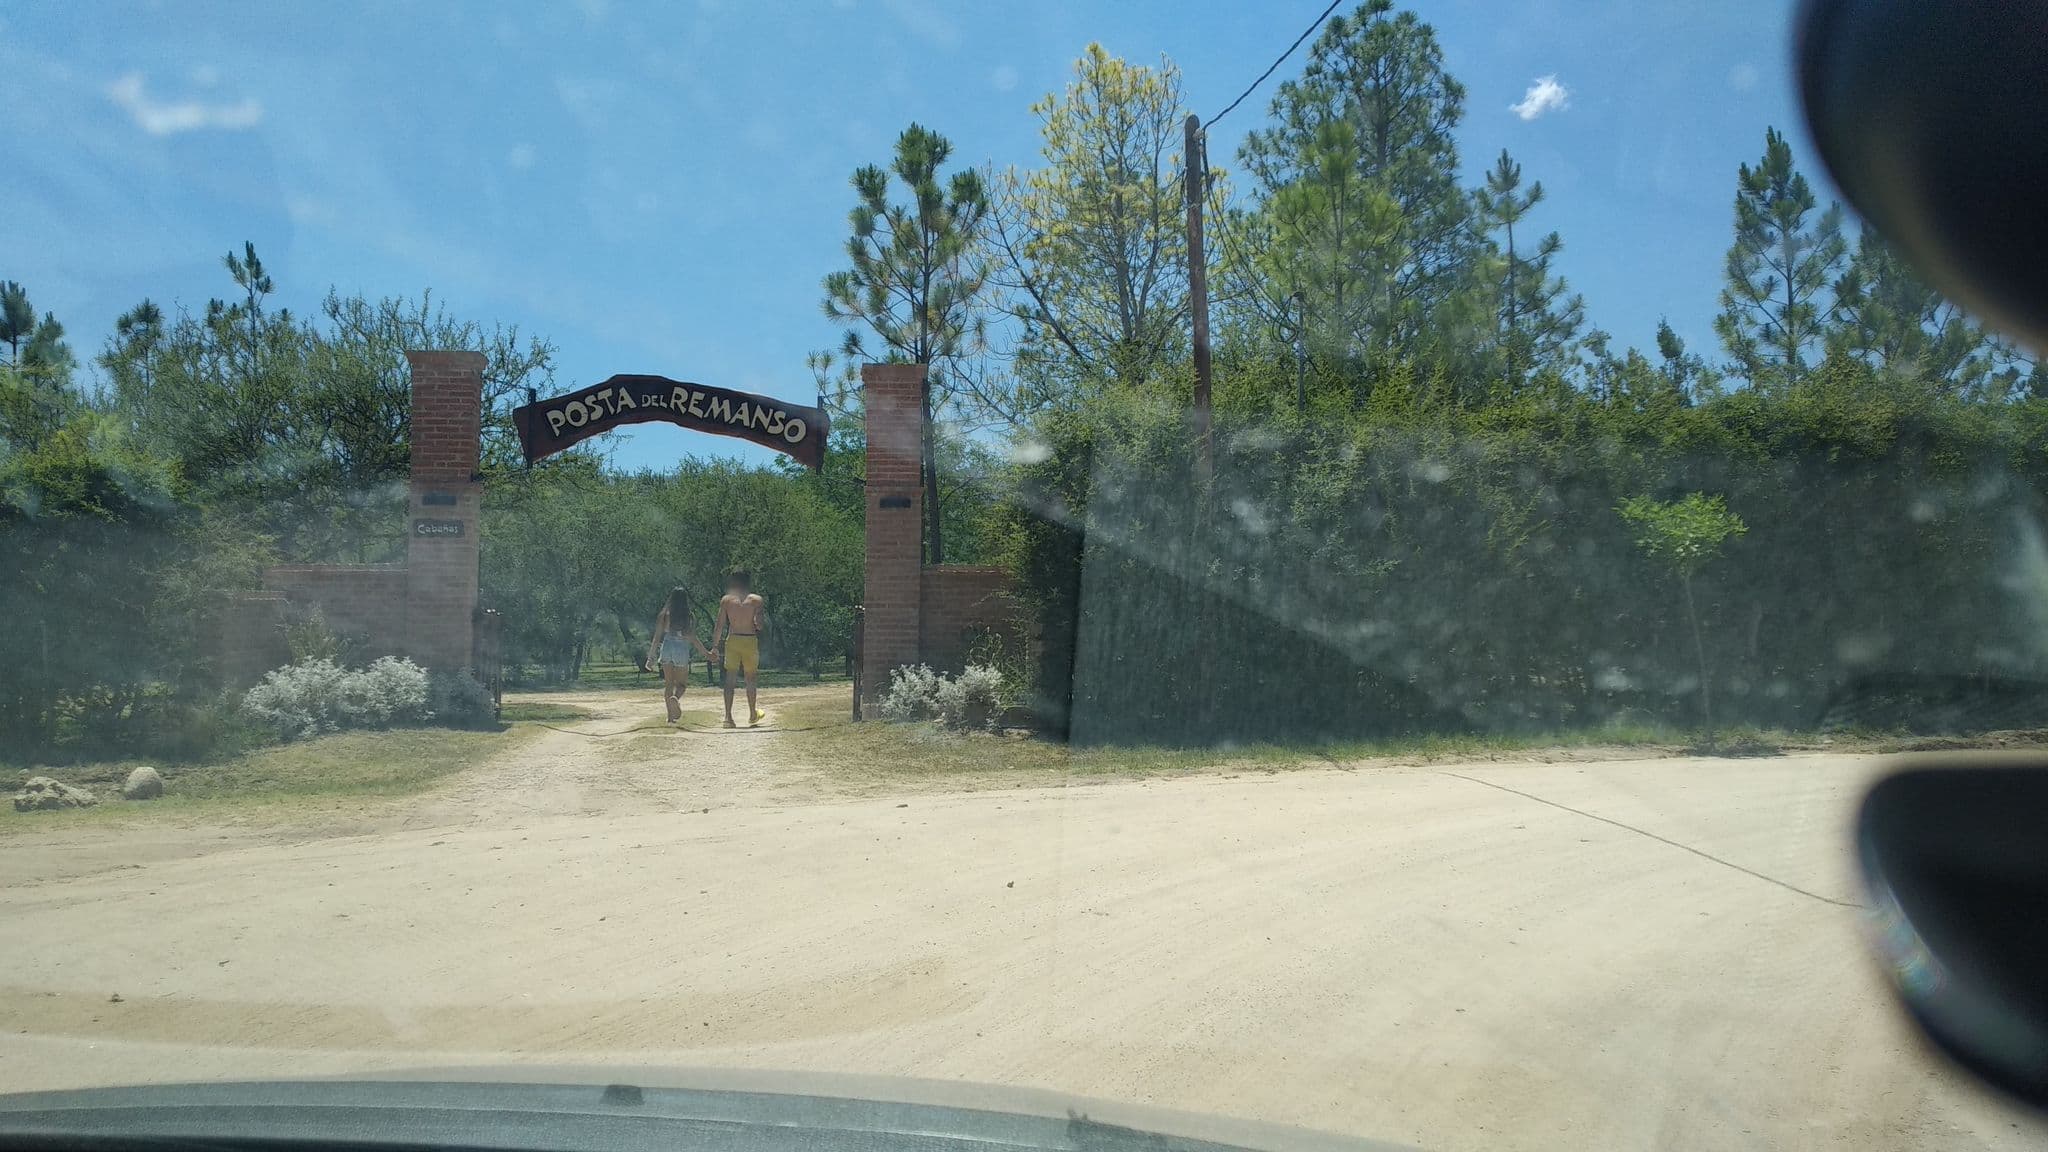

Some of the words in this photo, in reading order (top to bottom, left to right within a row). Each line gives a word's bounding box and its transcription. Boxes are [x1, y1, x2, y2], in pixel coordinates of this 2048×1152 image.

[546, 386, 637, 437] POSTA
[641, 394, 668, 409] DEL
[670, 386, 807, 443] REMANSO
